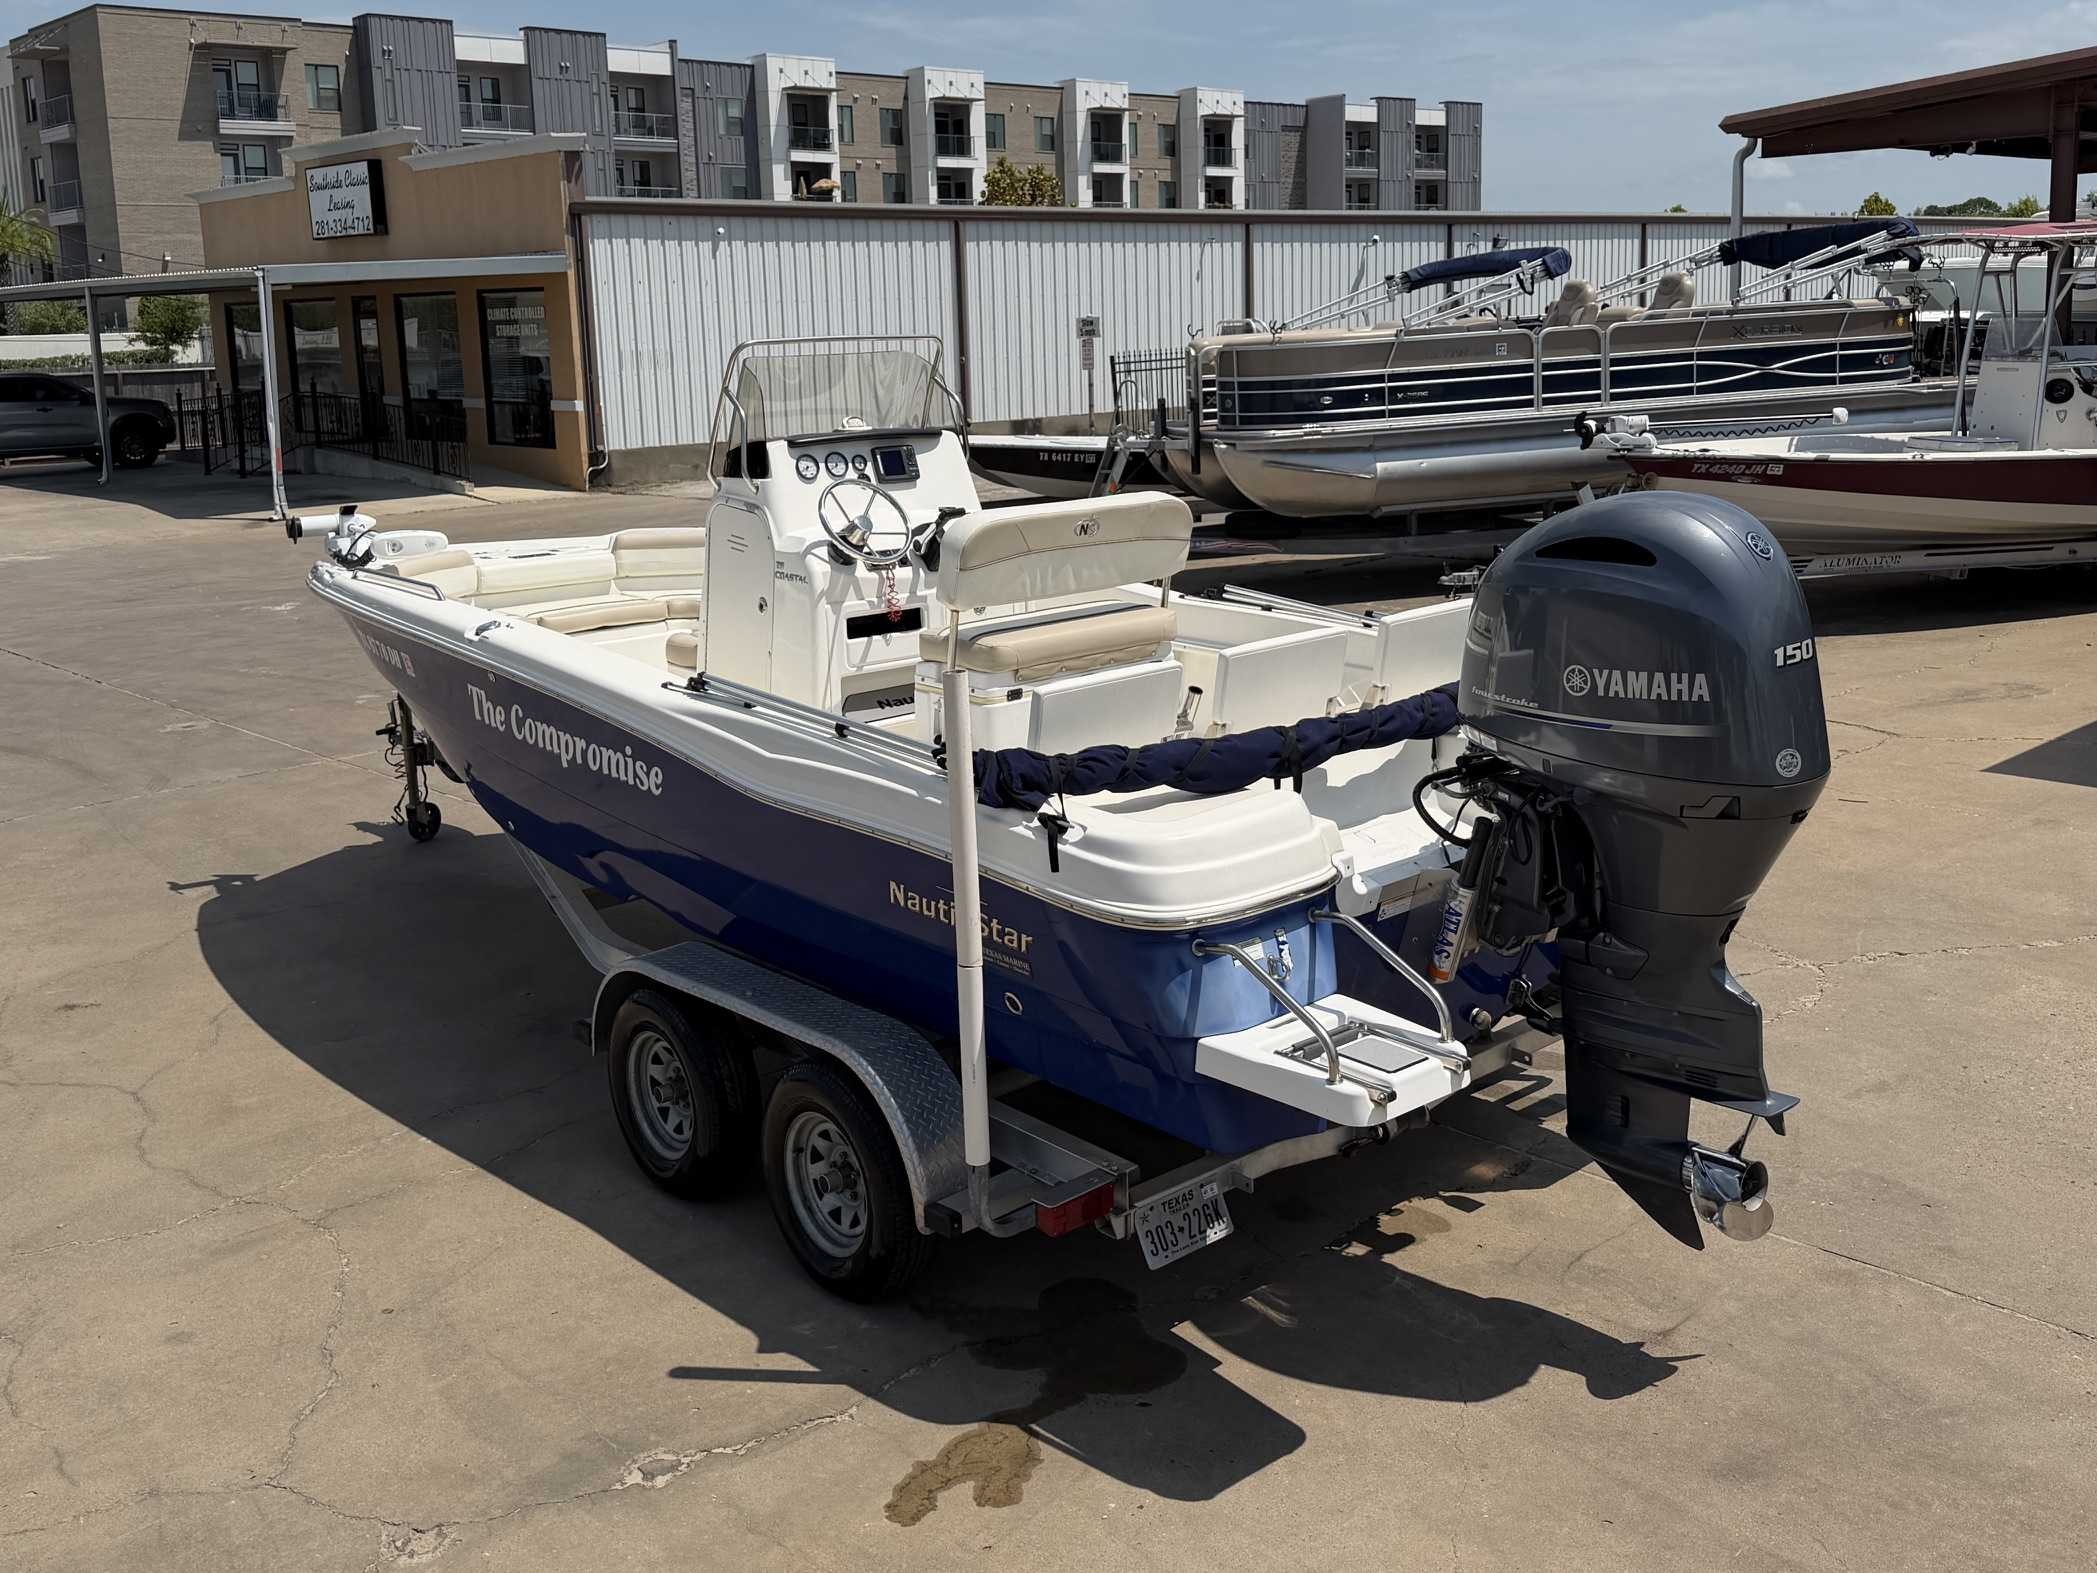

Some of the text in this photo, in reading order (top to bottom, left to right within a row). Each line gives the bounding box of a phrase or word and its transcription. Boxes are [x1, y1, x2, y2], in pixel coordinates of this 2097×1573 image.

[309, 168, 368, 192] Southside Classic
[328, 194, 355, 216] Leasing
[315, 216, 371, 236] 281-334-4712
[487, 306, 544, 320] CLIMATE CONTROLLED
[1692, 463, 1709, 473] TX
[1774, 638, 1814, 668] 150
[1592, 668, 1711, 702] YAMAHA
[467, 683, 663, 796] The Compromise
[889, 880, 1033, 953] NautiStar
[1434, 902, 1462, 960] ATLAS
[1161, 1189, 1194, 1212] TEXAS
